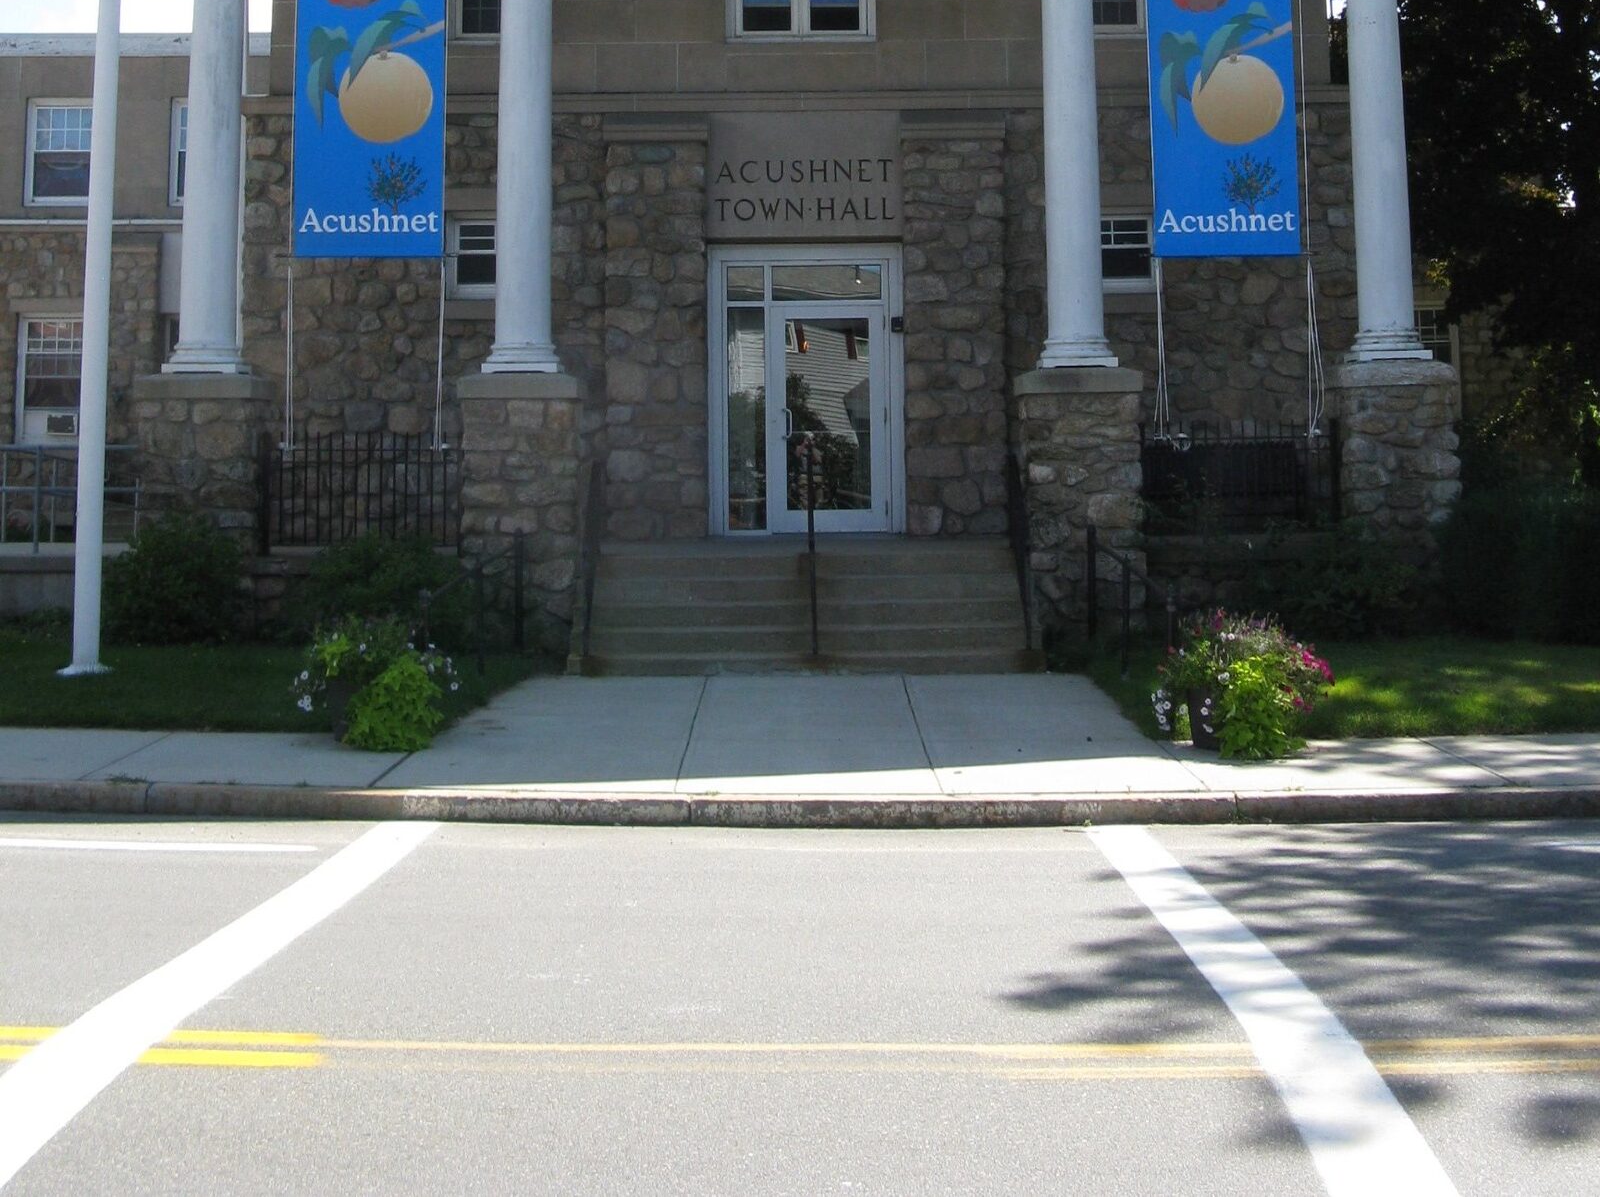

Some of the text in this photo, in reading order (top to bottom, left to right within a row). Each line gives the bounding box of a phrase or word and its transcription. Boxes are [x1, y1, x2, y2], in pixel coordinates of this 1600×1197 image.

[714, 158, 894, 184] ACUSHNET
[298, 207, 439, 234] Acushnet
[1157, 207, 1296, 234] Acushnet
